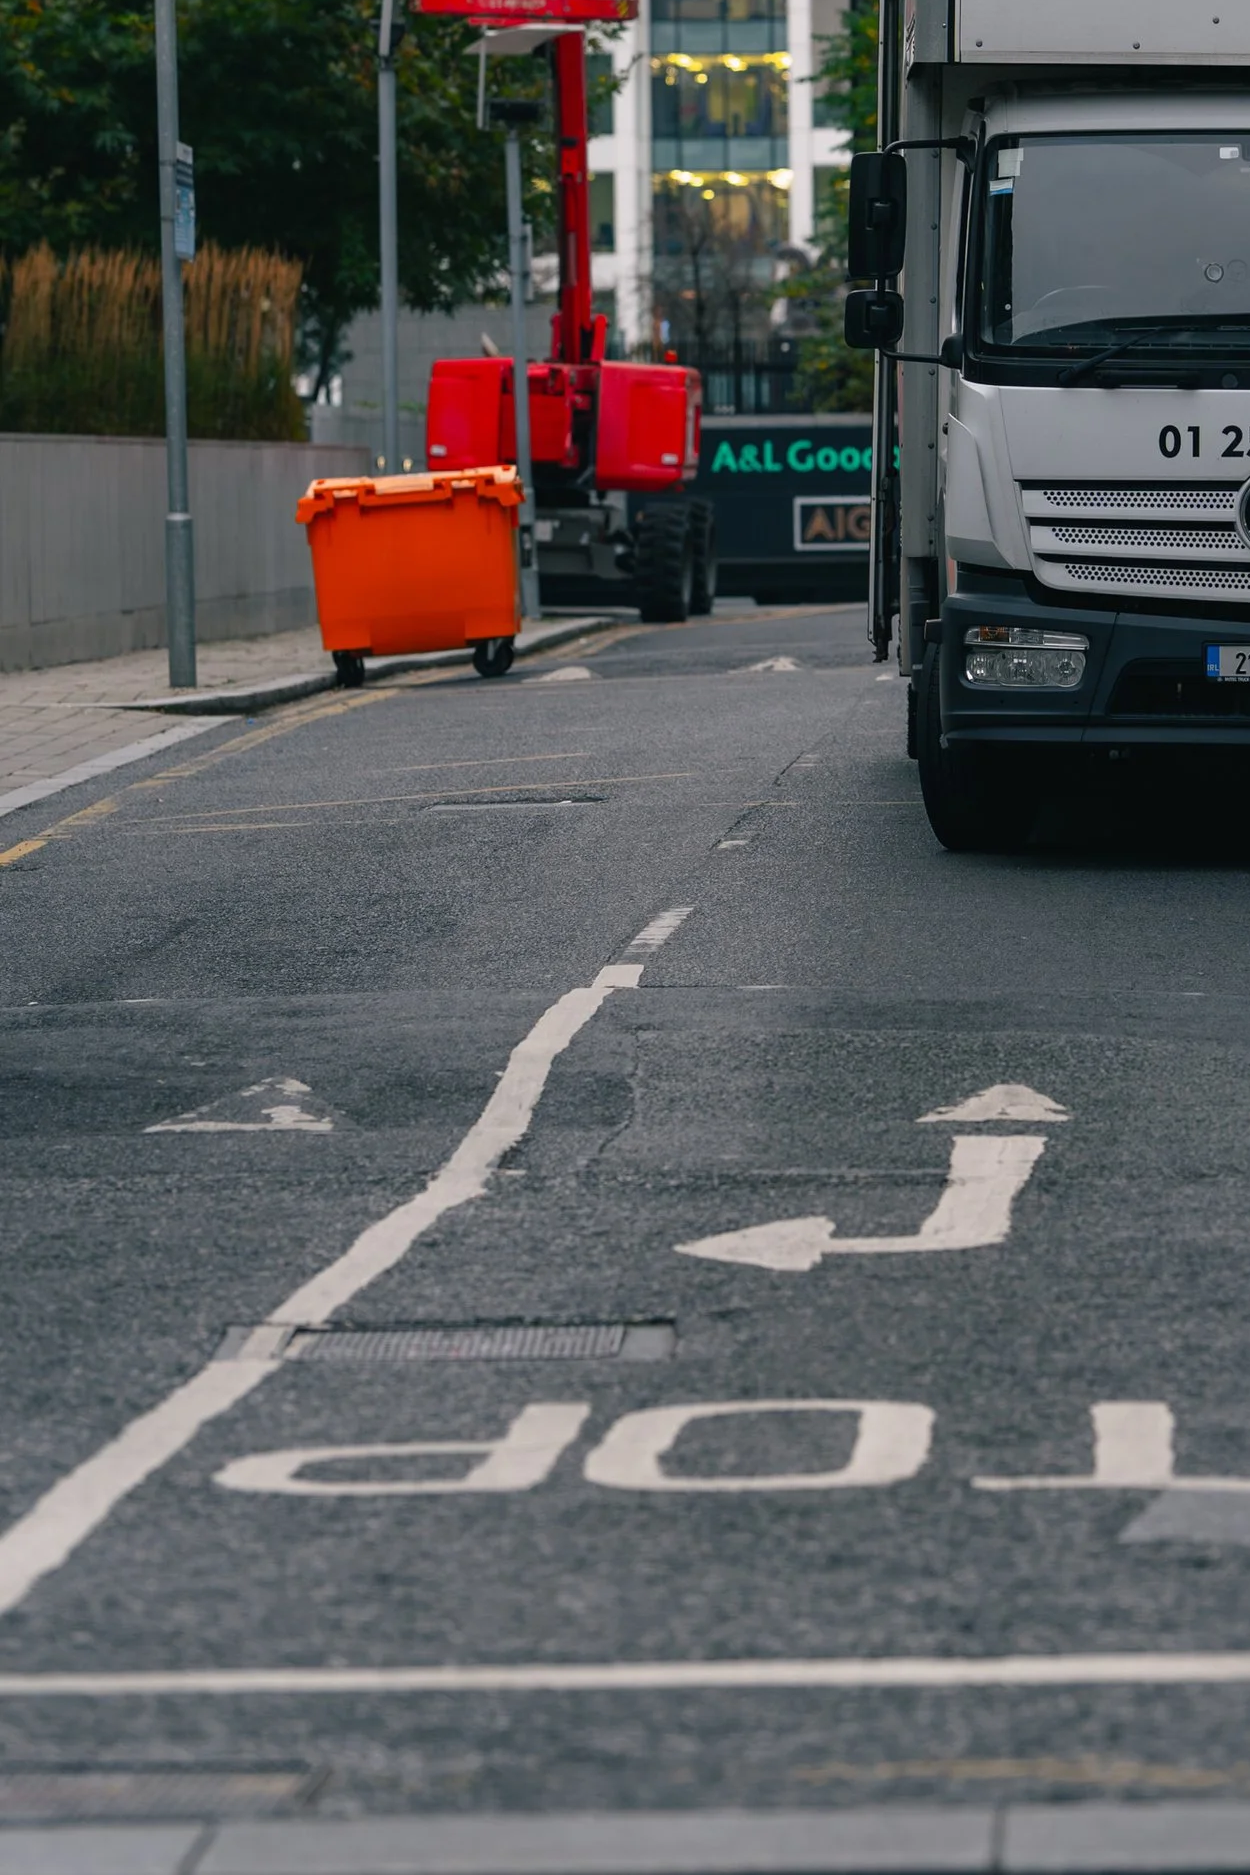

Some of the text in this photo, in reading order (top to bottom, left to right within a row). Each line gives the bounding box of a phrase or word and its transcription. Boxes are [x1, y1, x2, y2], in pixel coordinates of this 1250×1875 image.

[711, 440, 783, 473] A&L
[1159, 426, 1202, 458] 01
[804, 506, 871, 541] AIG
